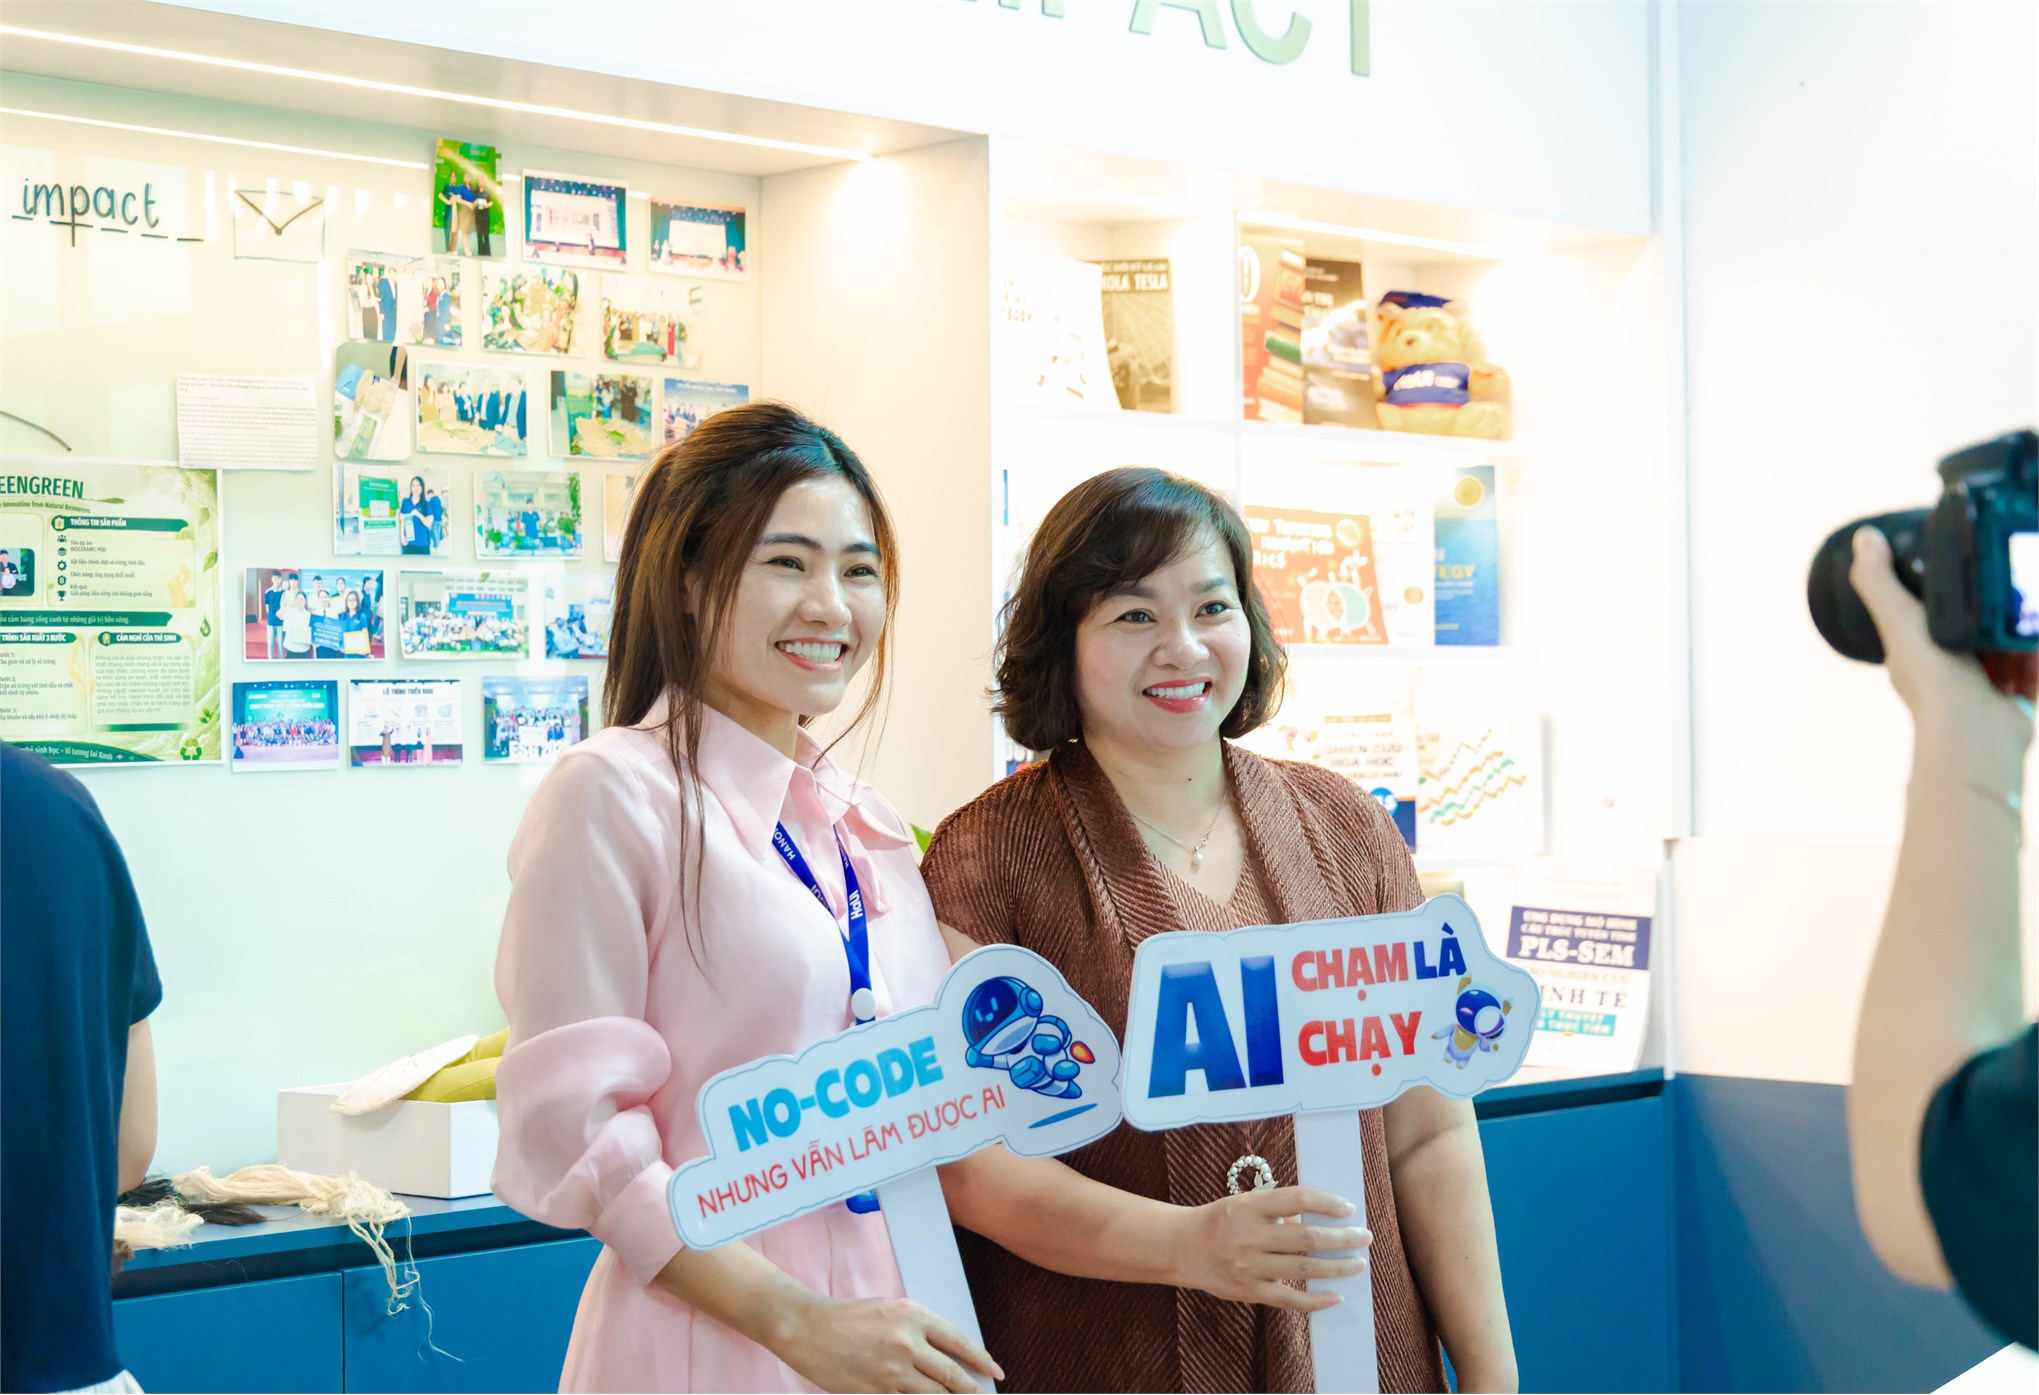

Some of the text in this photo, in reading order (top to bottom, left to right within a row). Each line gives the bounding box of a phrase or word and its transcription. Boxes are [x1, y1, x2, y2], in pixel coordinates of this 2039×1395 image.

[21, 178, 160, 247] impact
[1133, 273, 1168, 291] TESLA
[31, 500, 44, 508] from
[44, 502, 64, 510] Natural
[65, 504, 91, 514] Resources
[1291, 921, 1467, 1002] CHẠM LÀ
[1518, 936, 1635, 967] PLS-SEM
[1148, 955, 1284, 1098] AI
[1540, 985, 1585, 1005] INH
[1298, 1010, 1423, 1077] CHẠY
[728, 1035, 944, 1152] NO-CODE
[697, 1163, 789, 1218] NHƯNG
[791, 1138, 845, 1181] VẪN
[907, 1095, 978, 1140] ĐƯỢC
[983, 1084, 1006, 1114] AI
